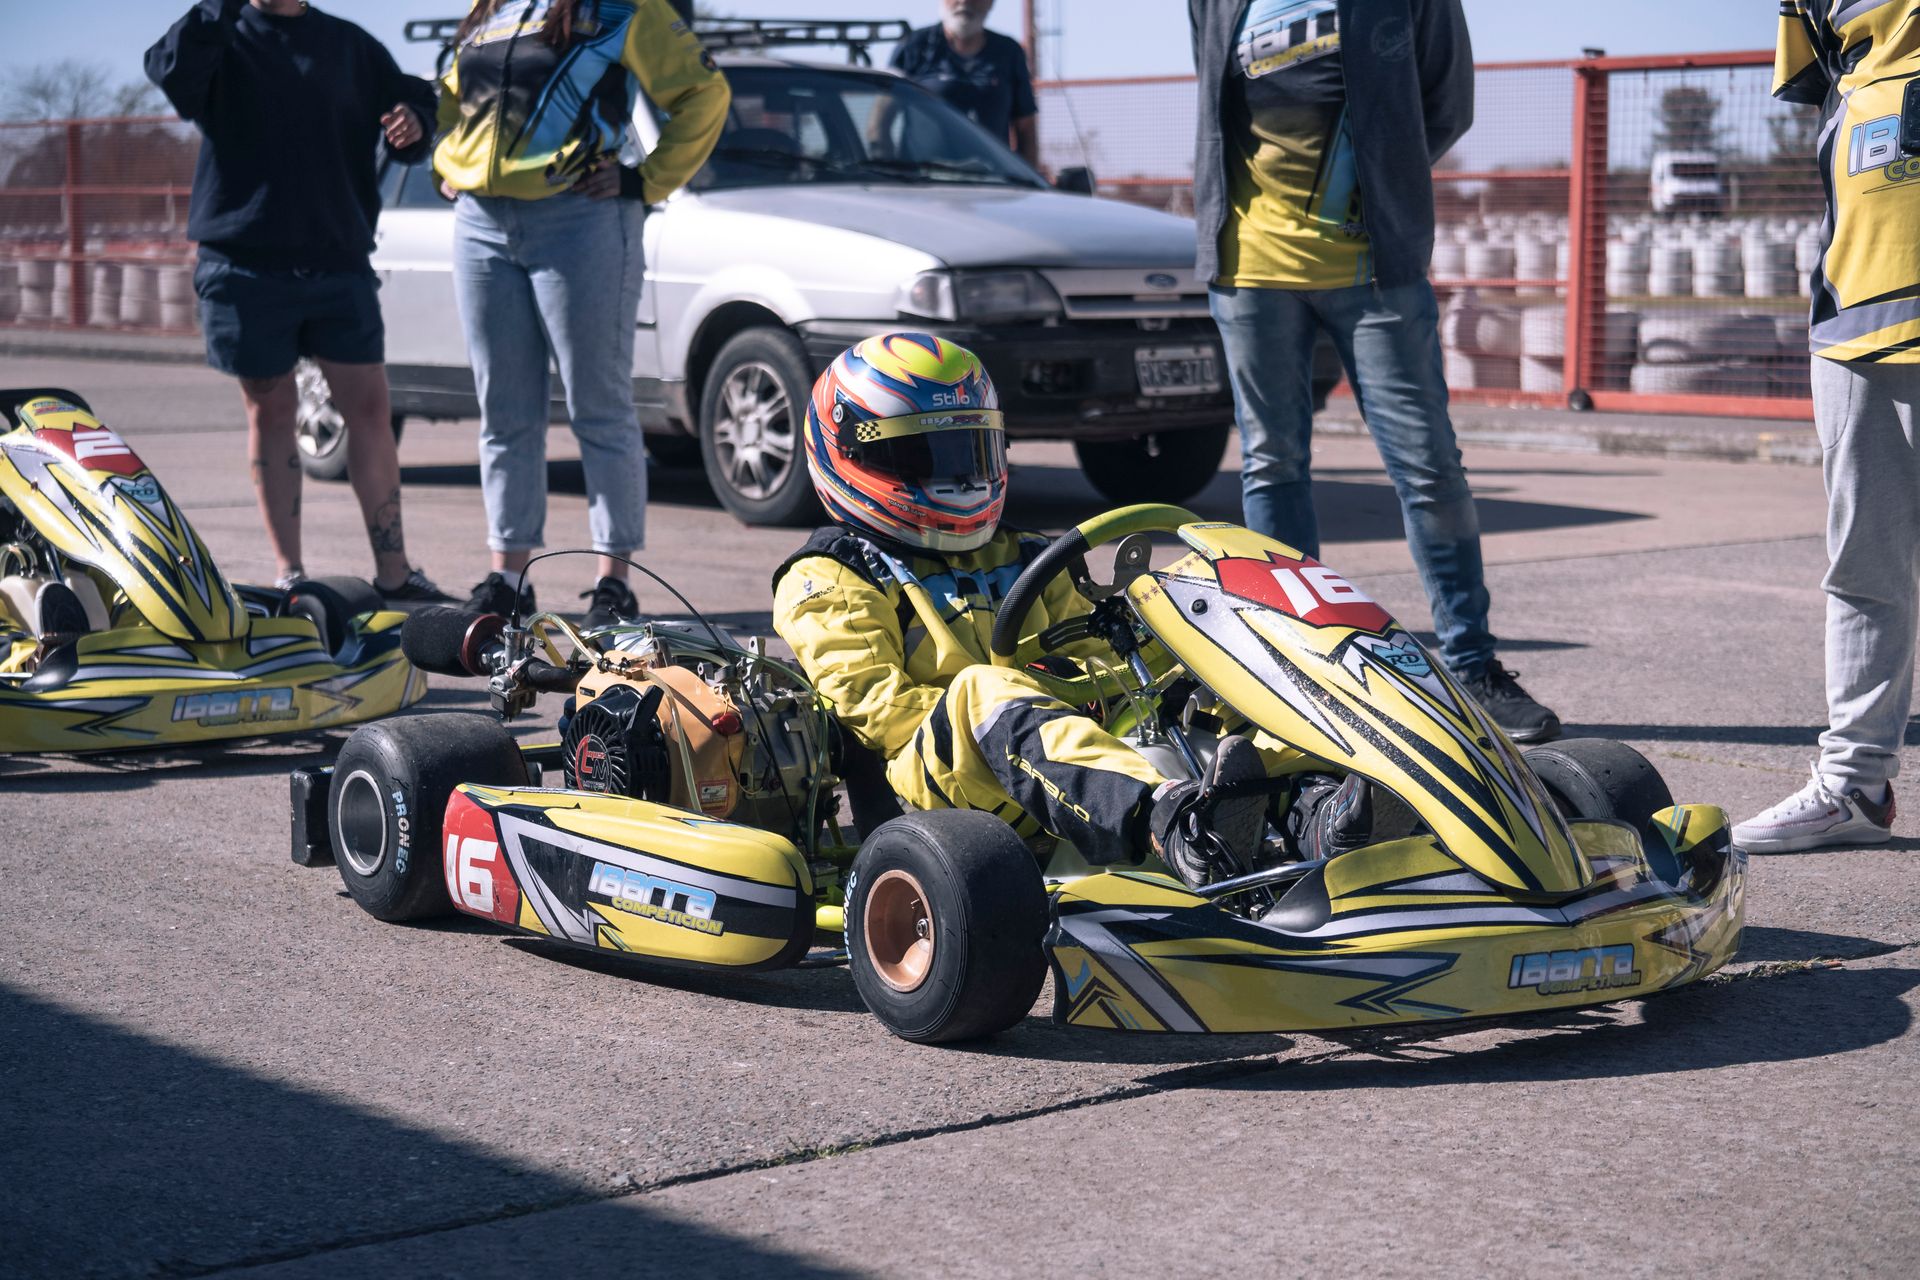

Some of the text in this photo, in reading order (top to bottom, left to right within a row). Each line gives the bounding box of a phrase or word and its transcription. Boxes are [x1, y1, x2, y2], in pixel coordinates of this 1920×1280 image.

[932, 387, 971, 407] Stilo
[72, 431, 132, 463] 2
[1270, 566, 1378, 619] 16
[446, 833, 499, 914] 16
[610, 894, 725, 936] COMPETICION
